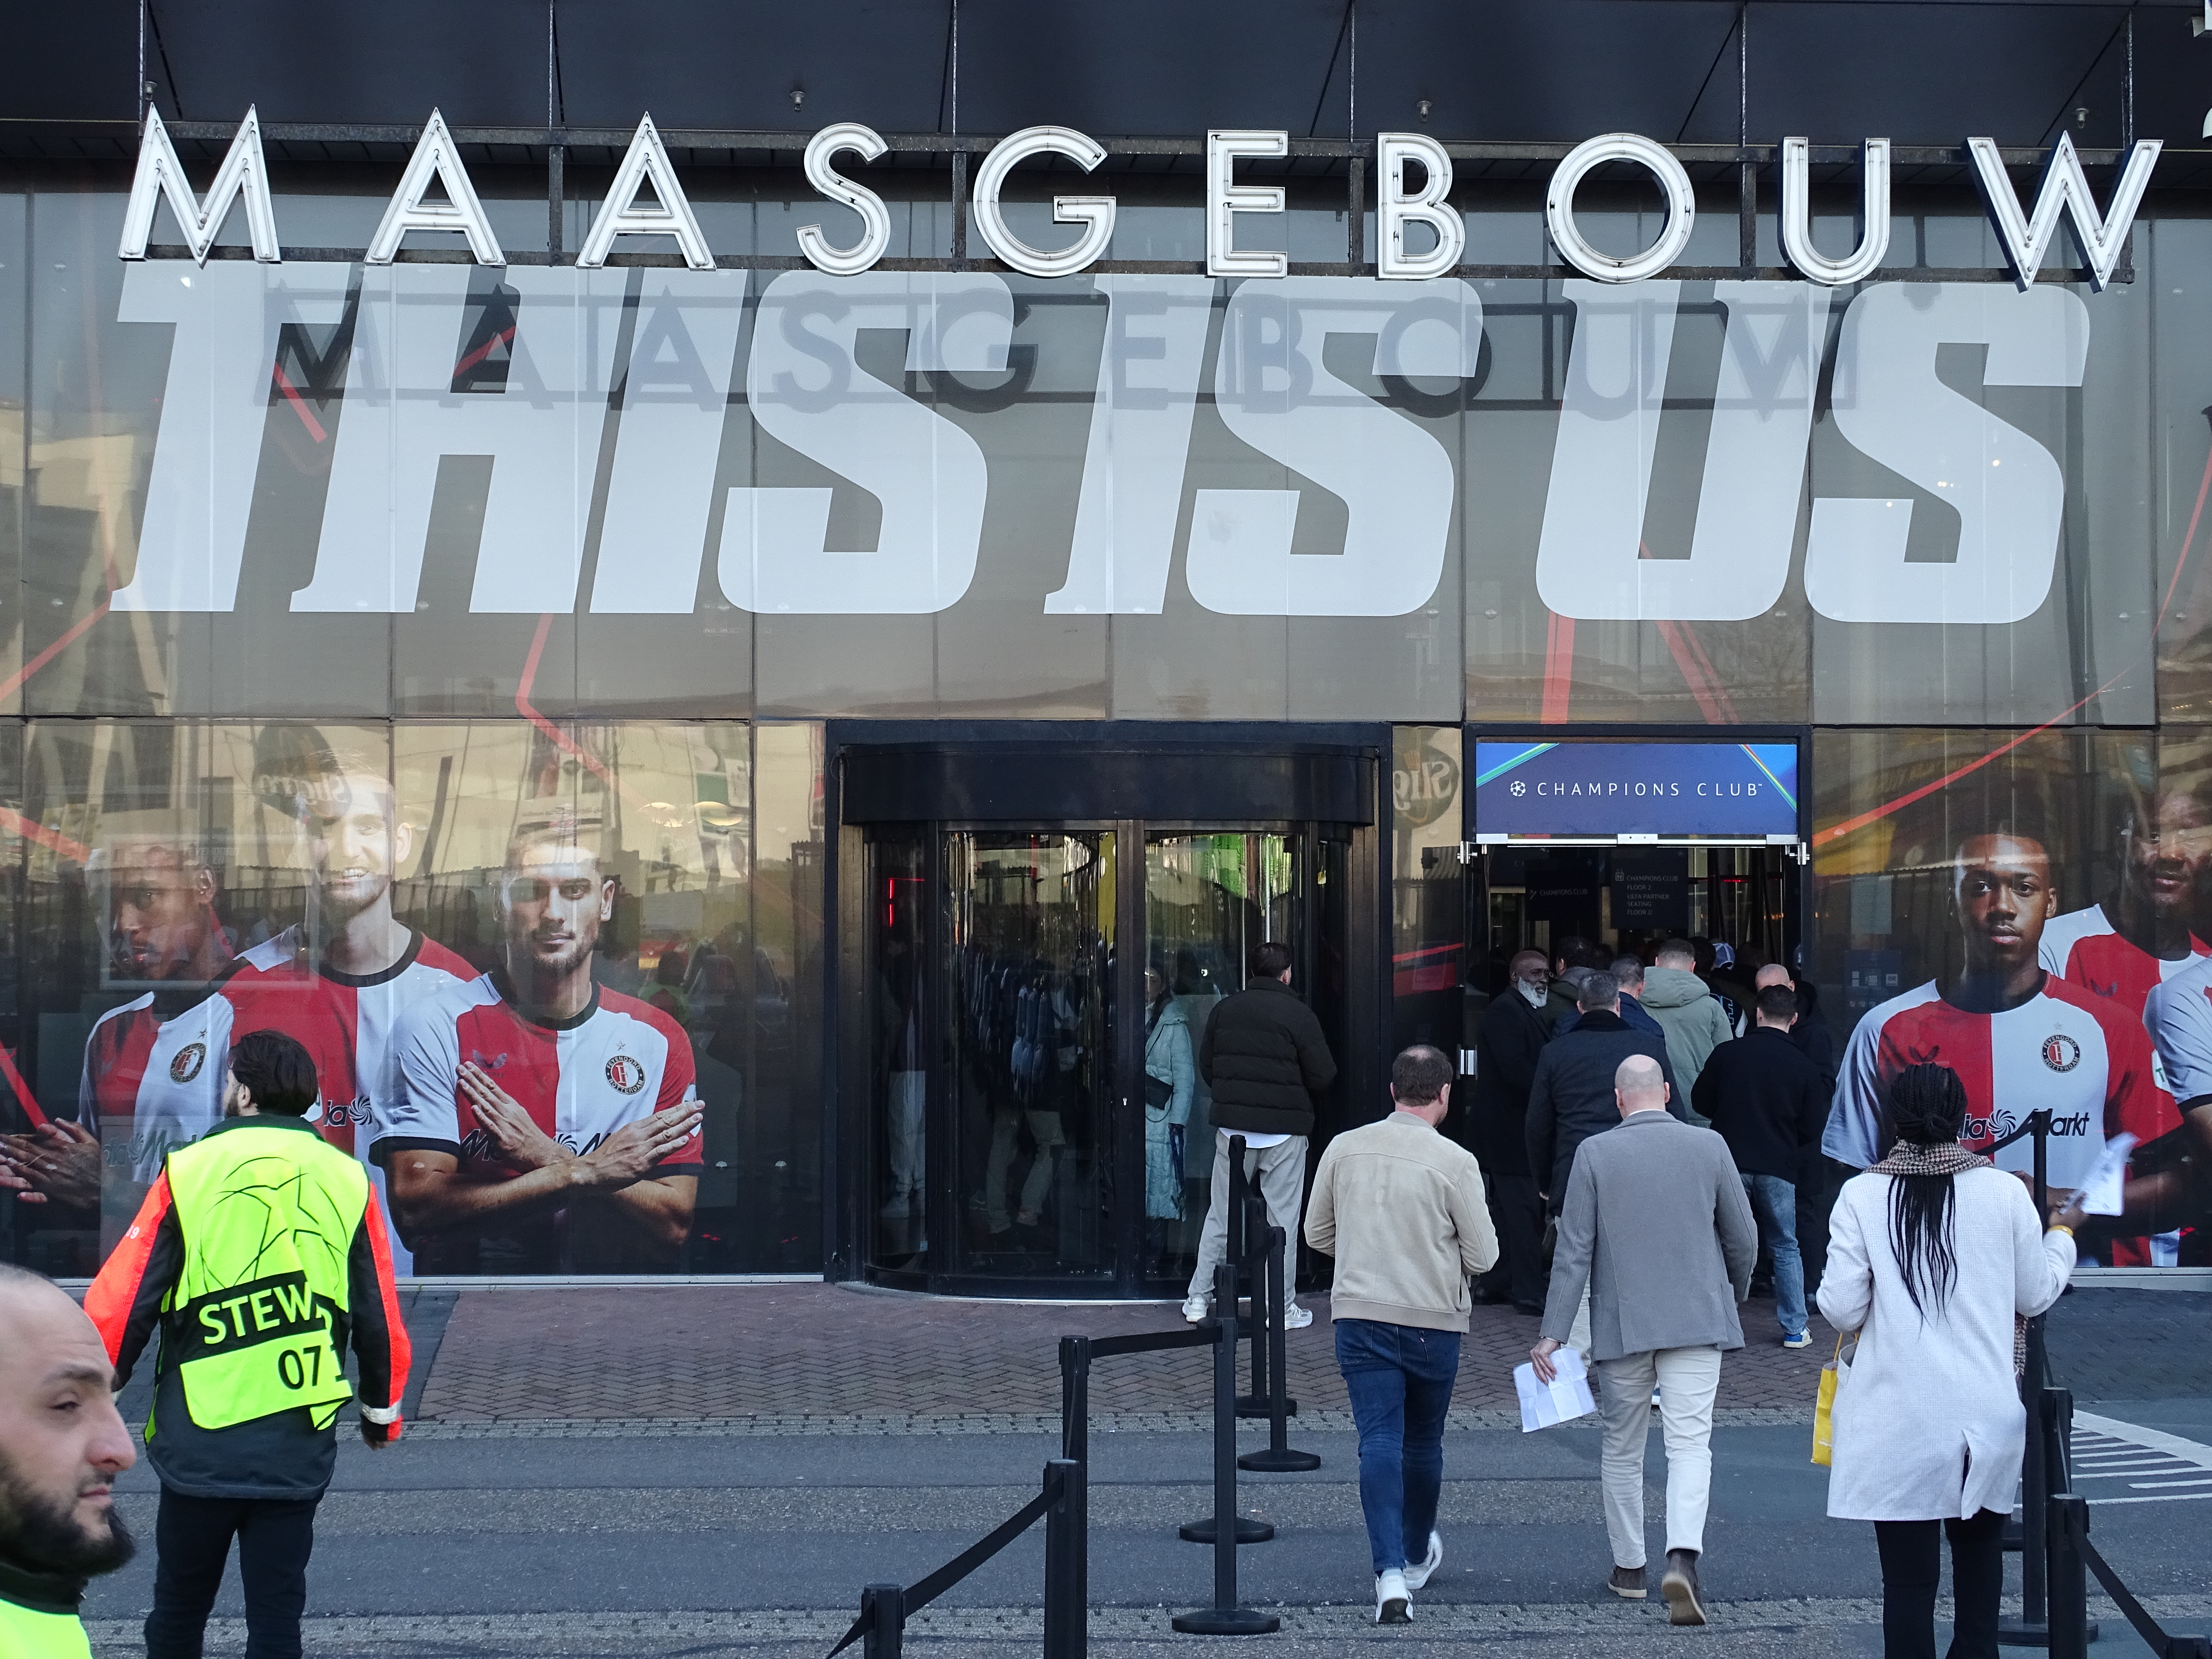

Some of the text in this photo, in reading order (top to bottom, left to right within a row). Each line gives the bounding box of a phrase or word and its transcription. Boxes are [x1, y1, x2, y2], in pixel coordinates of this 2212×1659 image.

[118, 102, 2163, 293] MAASGEBOUW
[109, 259, 2090, 623] THIS IS US
[1537, 782, 1679, 797] CHAMPIONS
[2043, 1035, 2077, 1048] FEYENOORD
[606, 1056, 641, 1070] FEYENOORD
[2044, 1057, 2079, 1071] ROTTERDAM
[608, 1078, 644, 1093] ROTTERDAM
